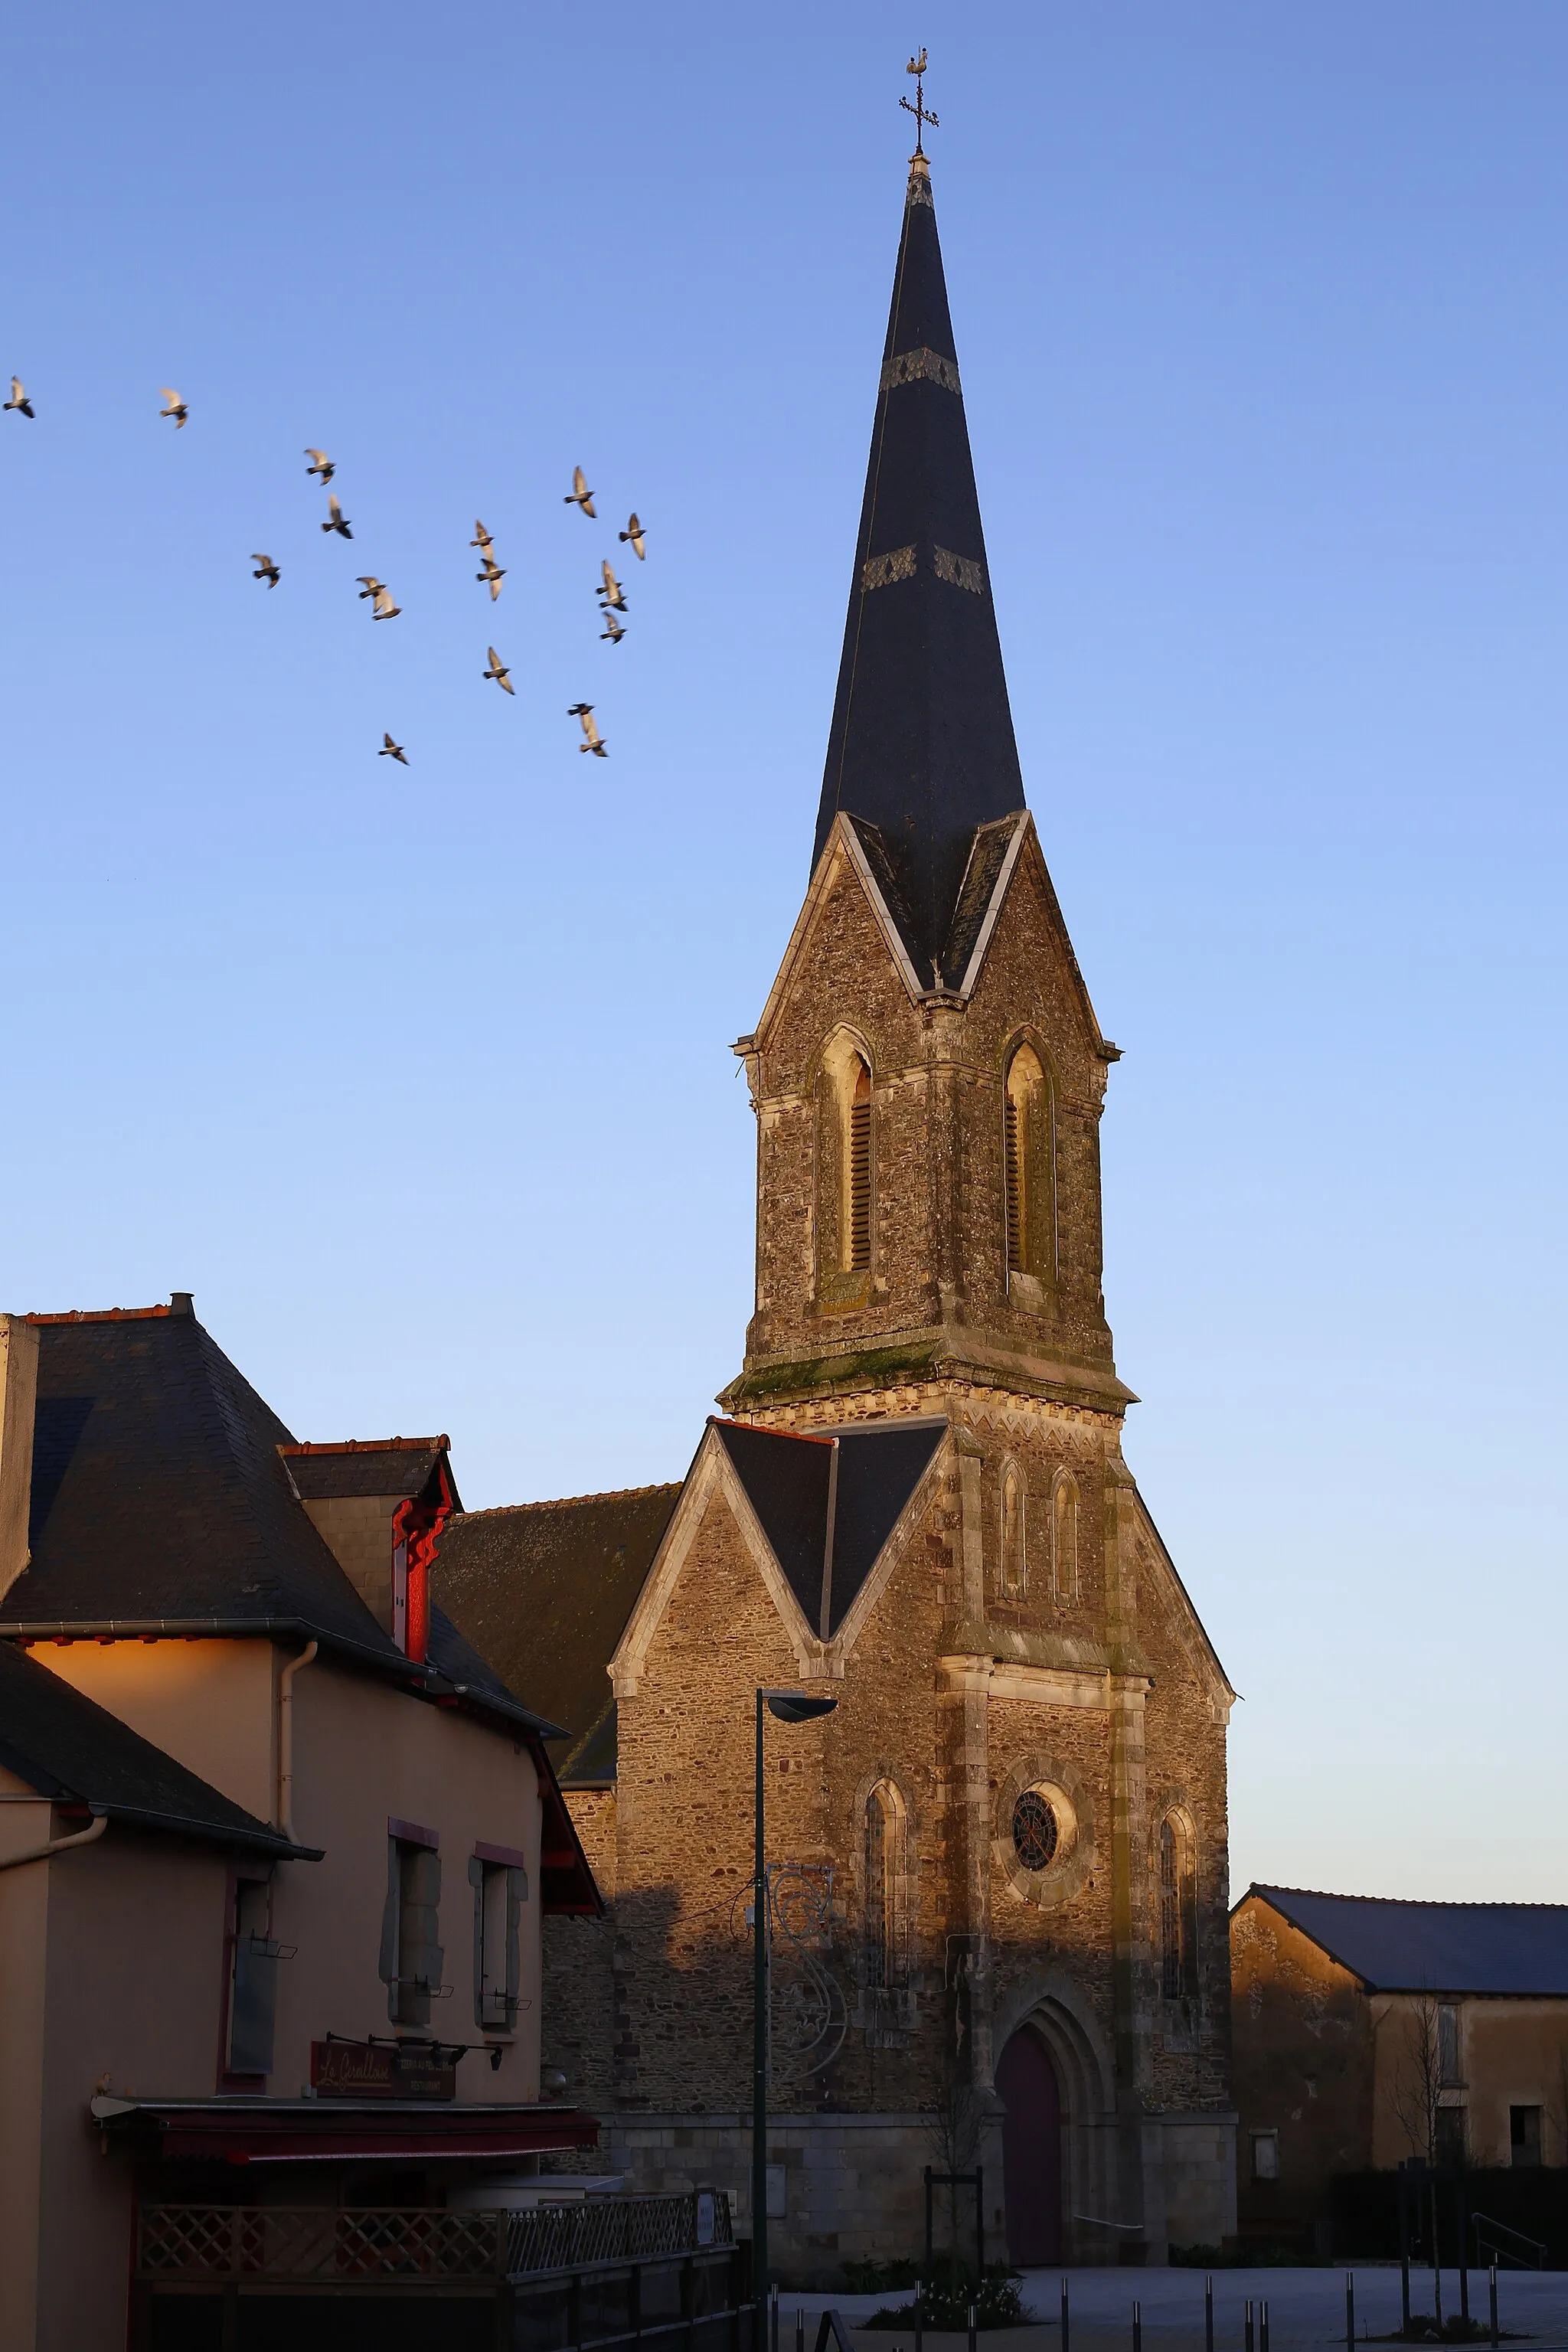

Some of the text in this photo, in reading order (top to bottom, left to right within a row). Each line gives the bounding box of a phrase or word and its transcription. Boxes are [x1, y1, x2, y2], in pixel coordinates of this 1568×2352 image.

[320, 2049, 336, 2086] La
[417, 2060, 425, 2071] AU
[410, 2081, 440, 2092] RESTAURANT
